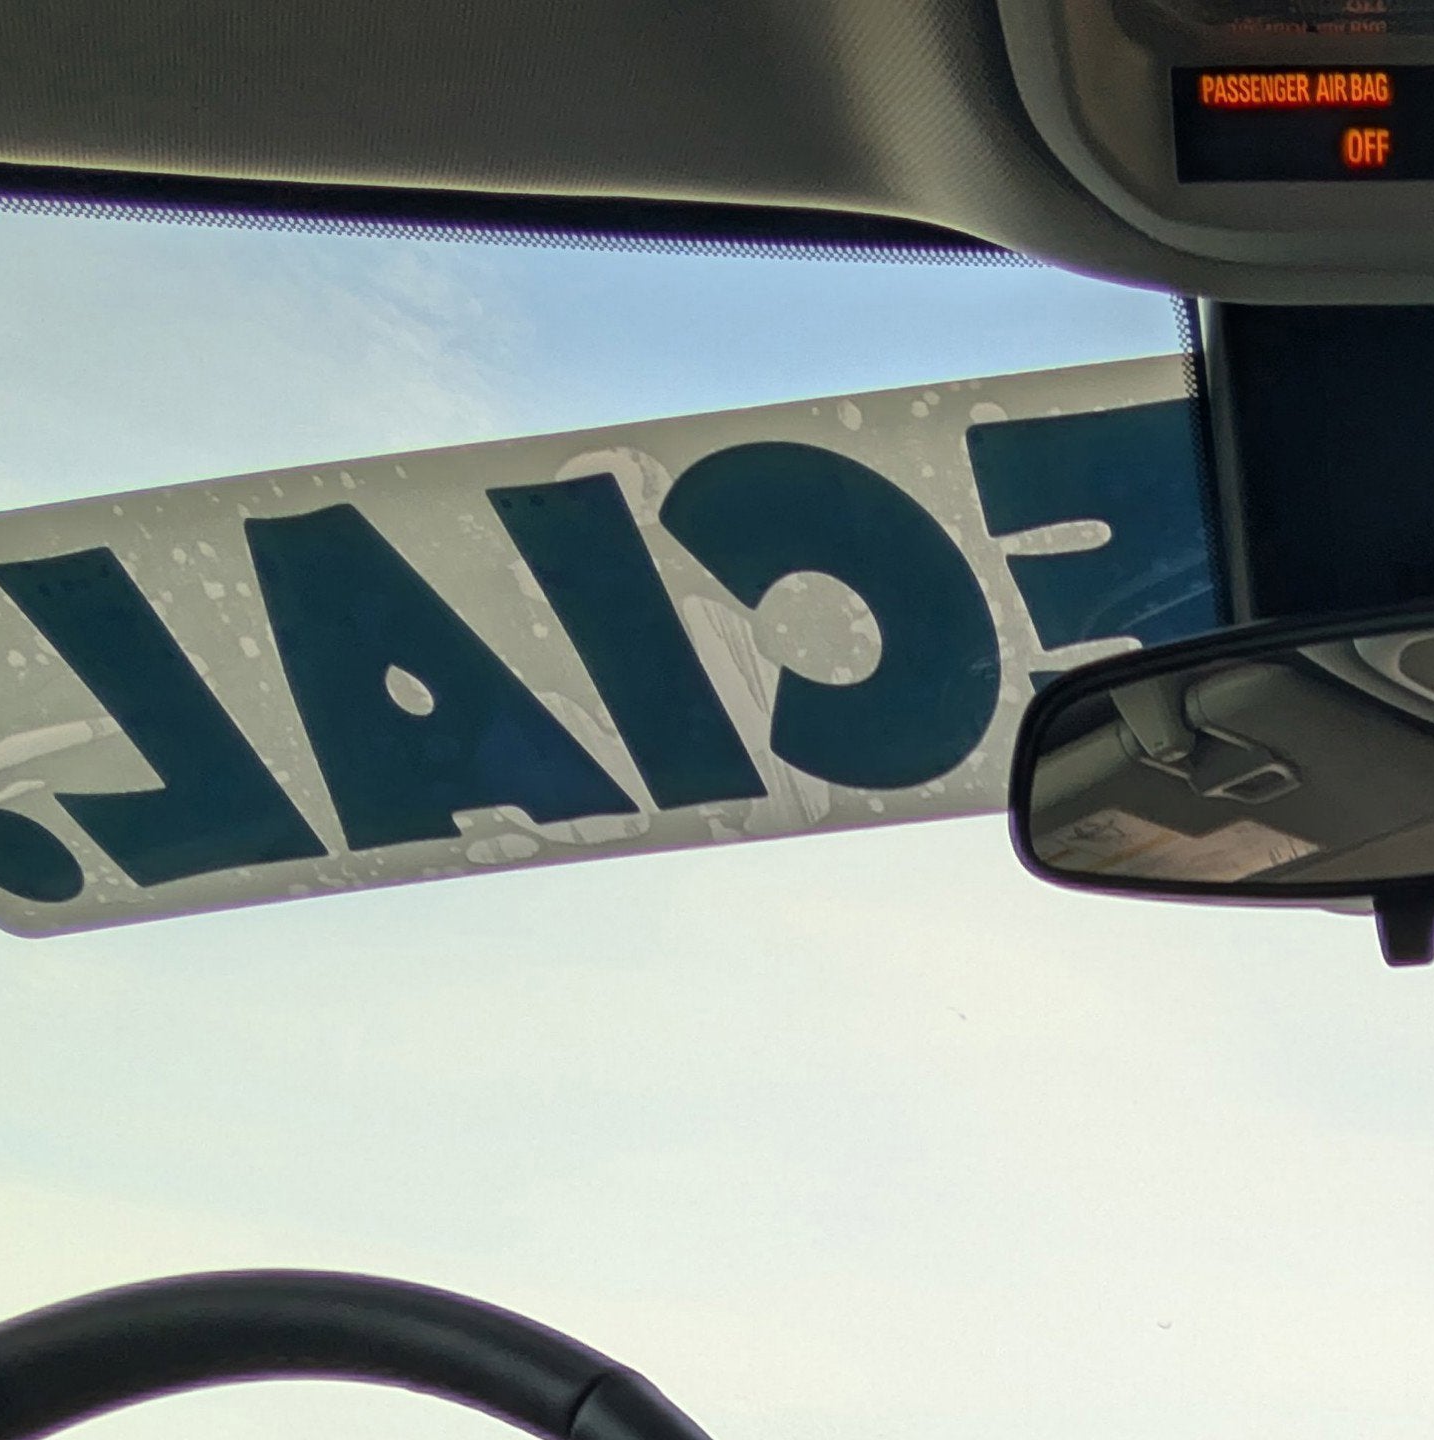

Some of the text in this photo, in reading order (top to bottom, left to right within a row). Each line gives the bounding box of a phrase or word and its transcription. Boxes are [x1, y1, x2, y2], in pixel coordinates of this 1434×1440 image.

[1200, 72, 1389, 103] PASSENGER AIR BAG
[1346, 127, 1390, 164] OFF
